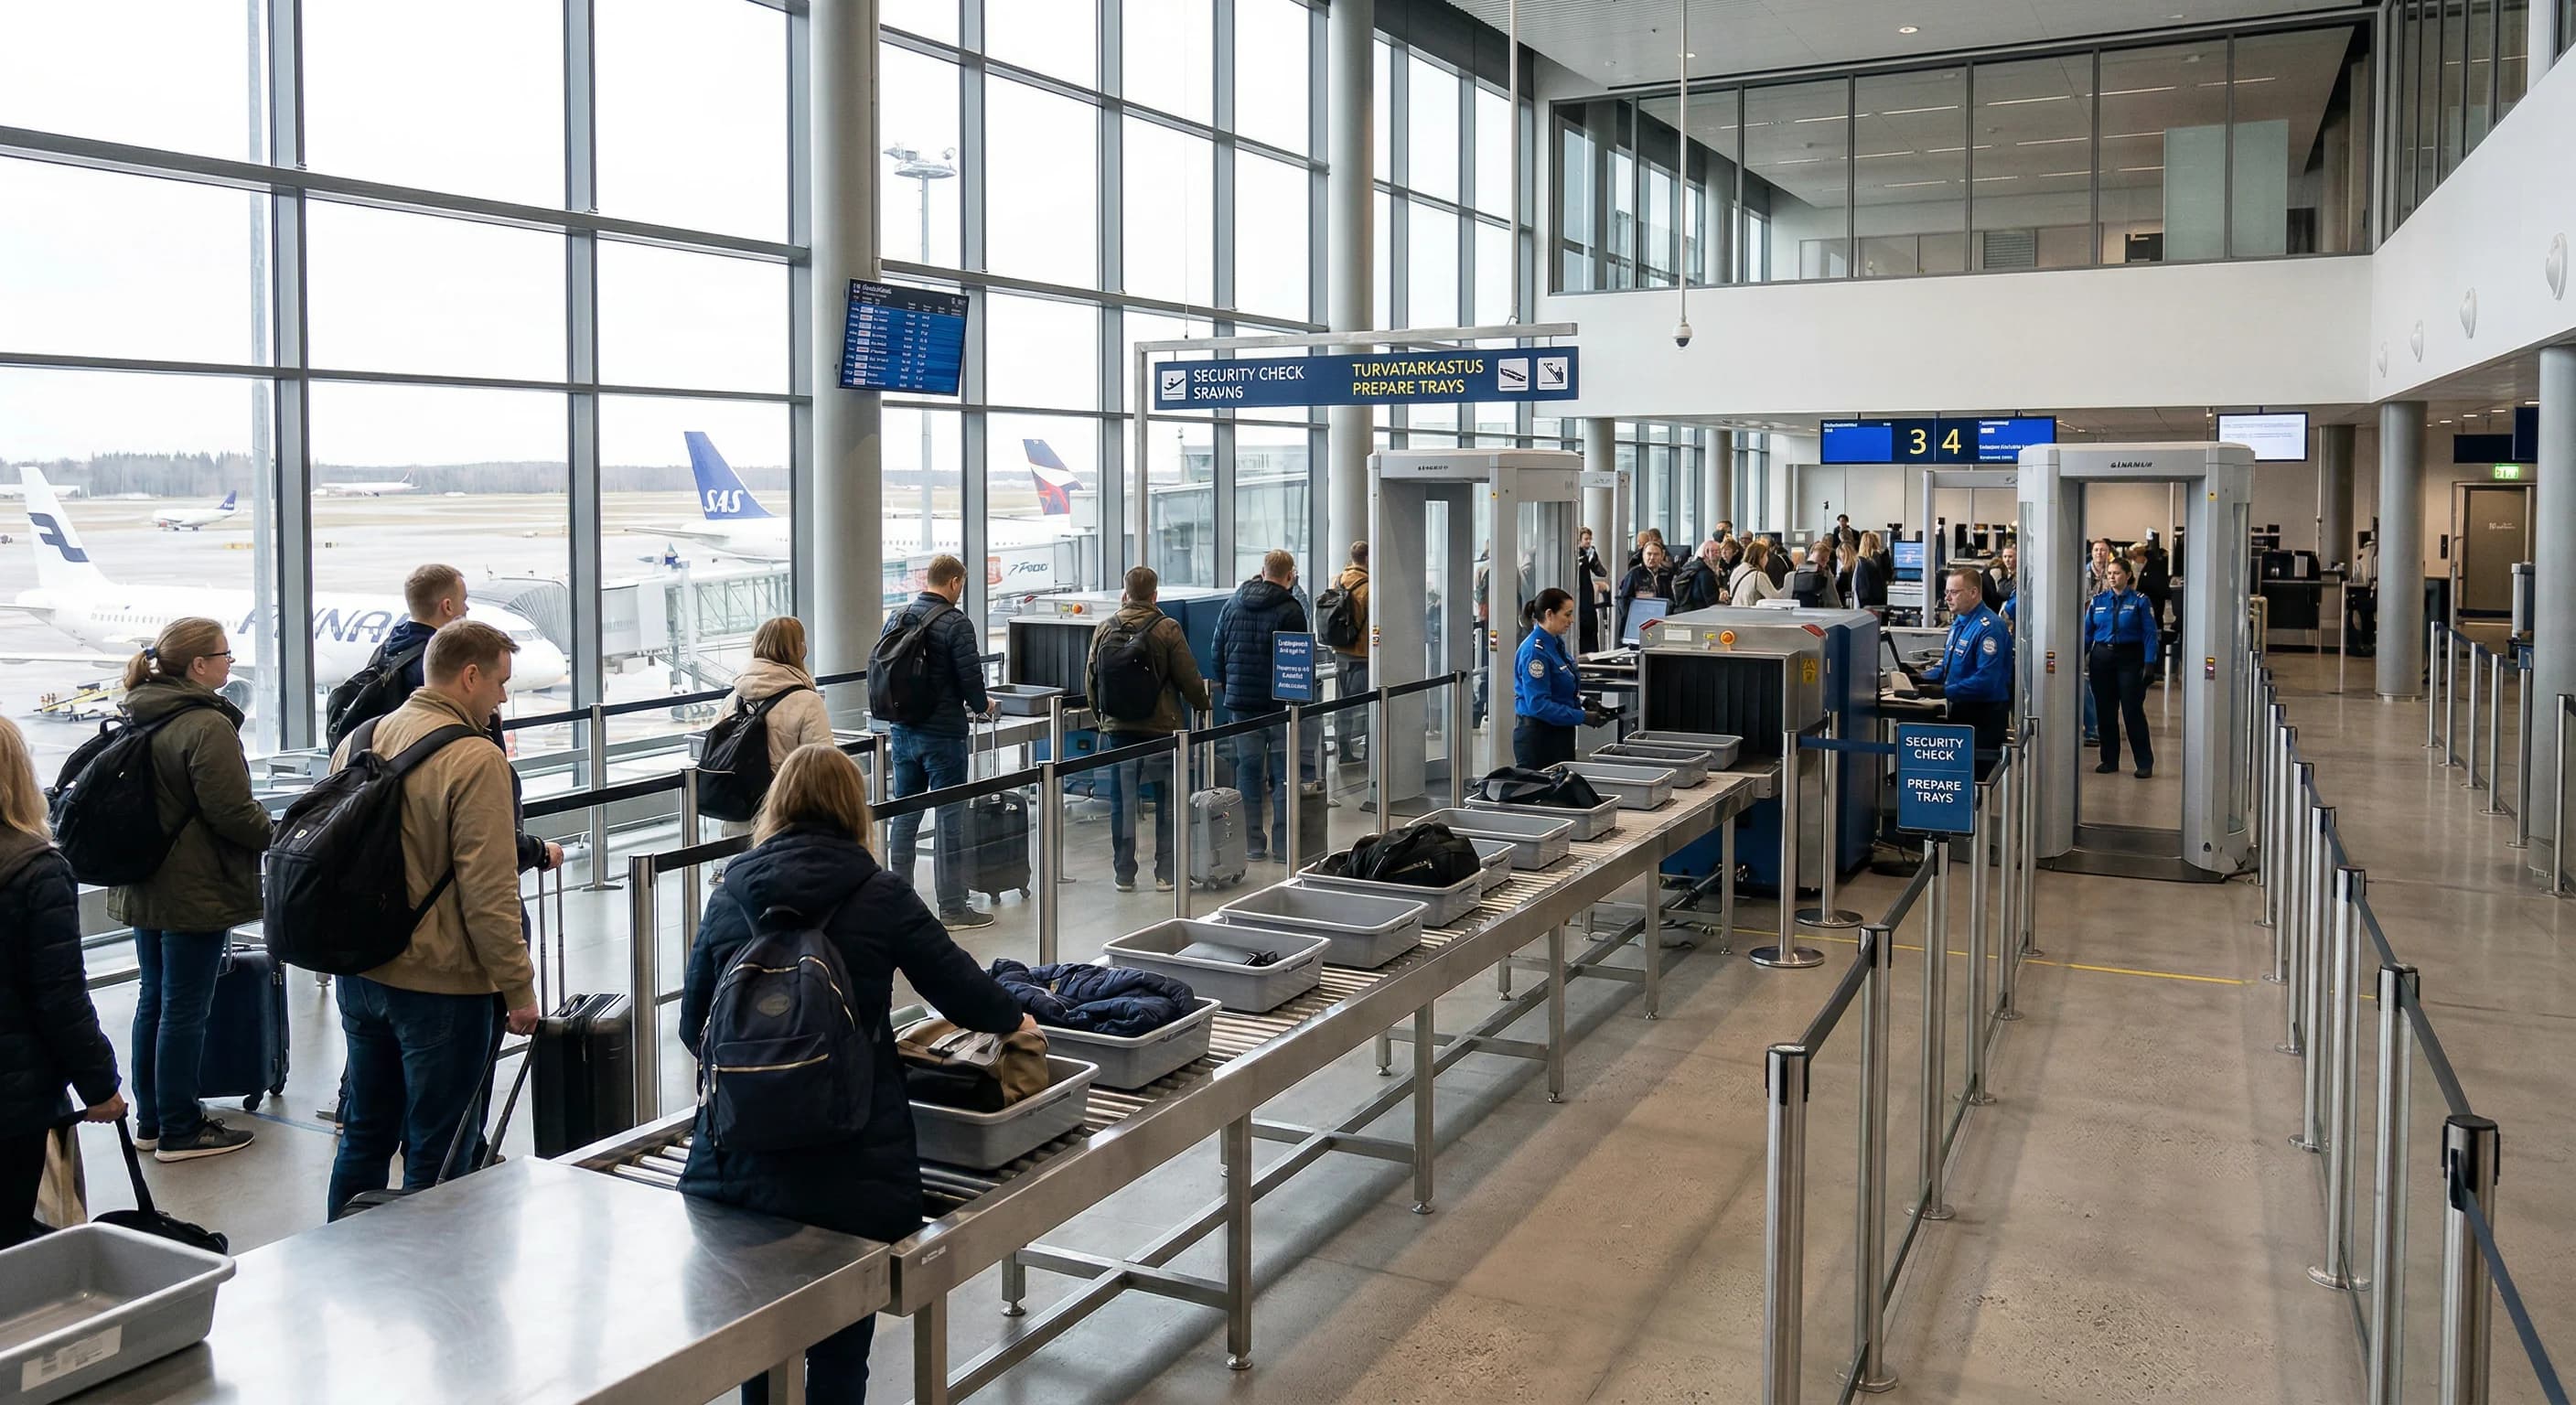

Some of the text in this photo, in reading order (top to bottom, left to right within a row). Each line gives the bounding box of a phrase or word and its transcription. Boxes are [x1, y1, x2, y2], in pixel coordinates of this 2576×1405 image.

[1193, 365, 1305, 383] SECURITY CHECK
[1352, 359, 1485, 378] TURVATARKASTUS
[1352, 379, 1465, 396] PREPARE TRAYS
[1908, 428, 1962, 456] 3 4
[703, 489, 744, 513] SAS
[1905, 736, 1964, 748] SECURITY
[1914, 749, 1955, 761] CHECK
[1907, 778, 1962, 791] PREPARE
[1916, 791, 1954, 803] TRAYS
